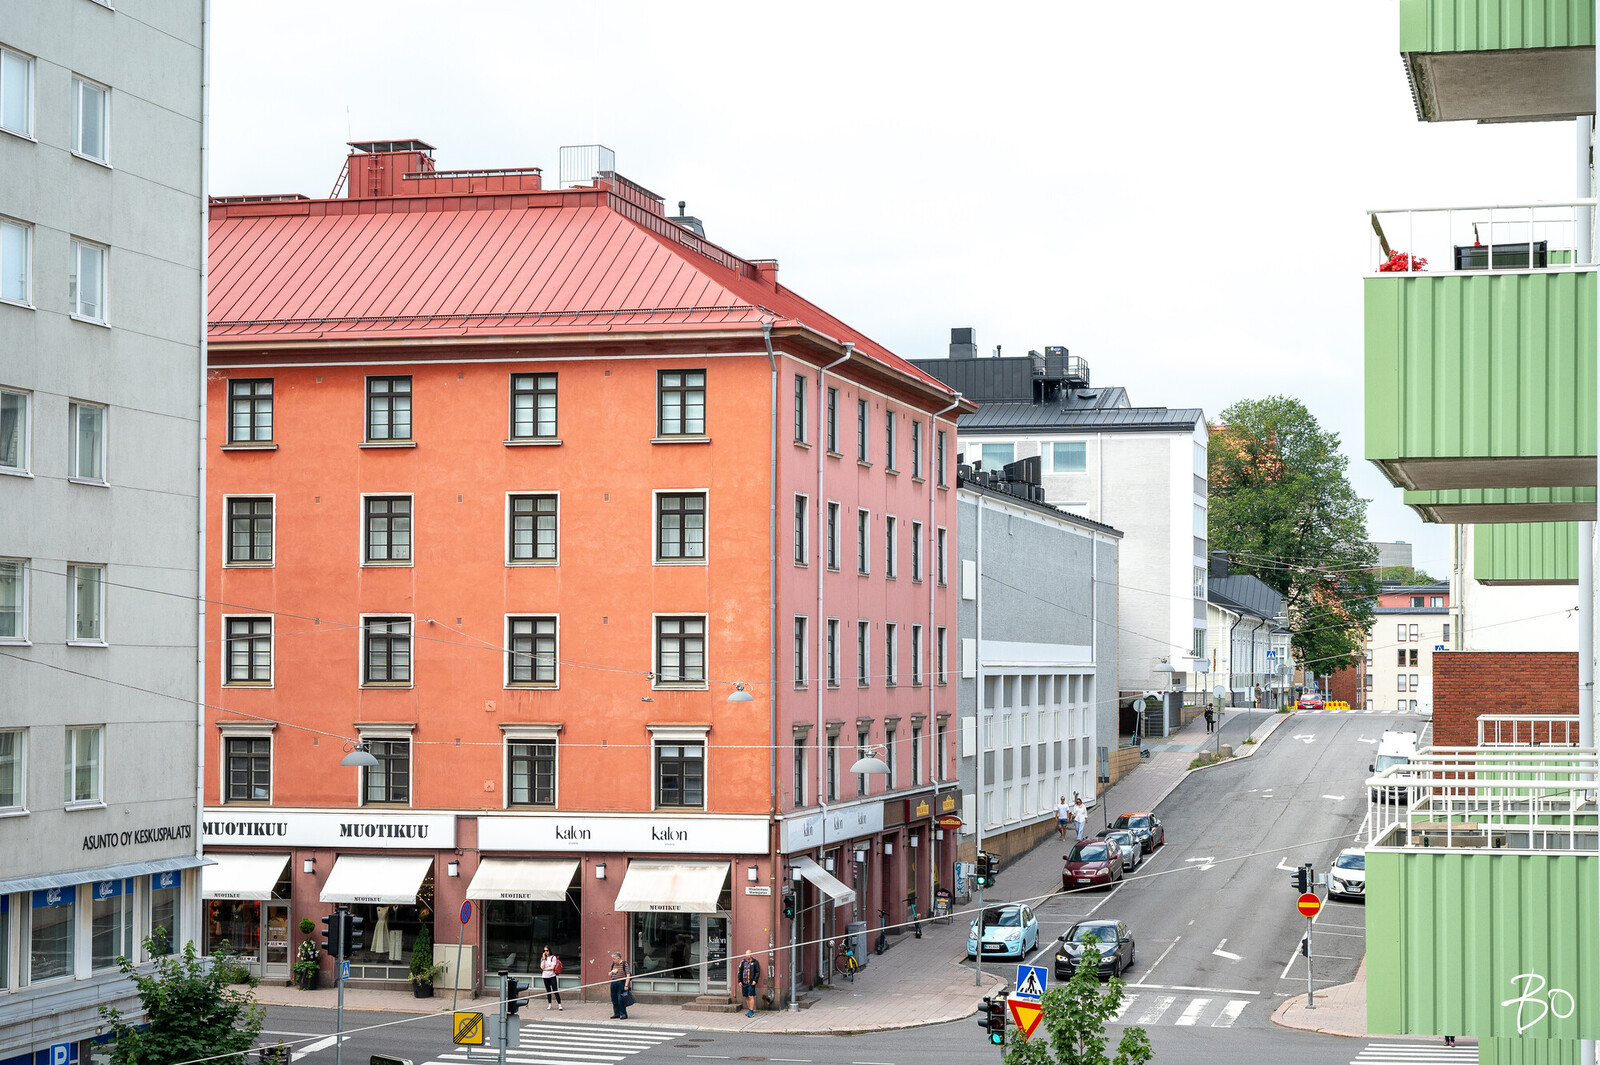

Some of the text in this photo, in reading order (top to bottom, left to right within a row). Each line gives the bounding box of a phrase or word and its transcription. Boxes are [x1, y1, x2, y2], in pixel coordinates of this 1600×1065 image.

[202, 822, 288, 837] MUOTIKUU
[339, 823, 429, 838] MUOTIKUU
[555, 825, 591, 840] kalon
[651, 826, 688, 841] kalon
[82, 825, 192, 850] ASUNTO OY KESKUSPALATSI
[54, 1045, 67, 1065] P
